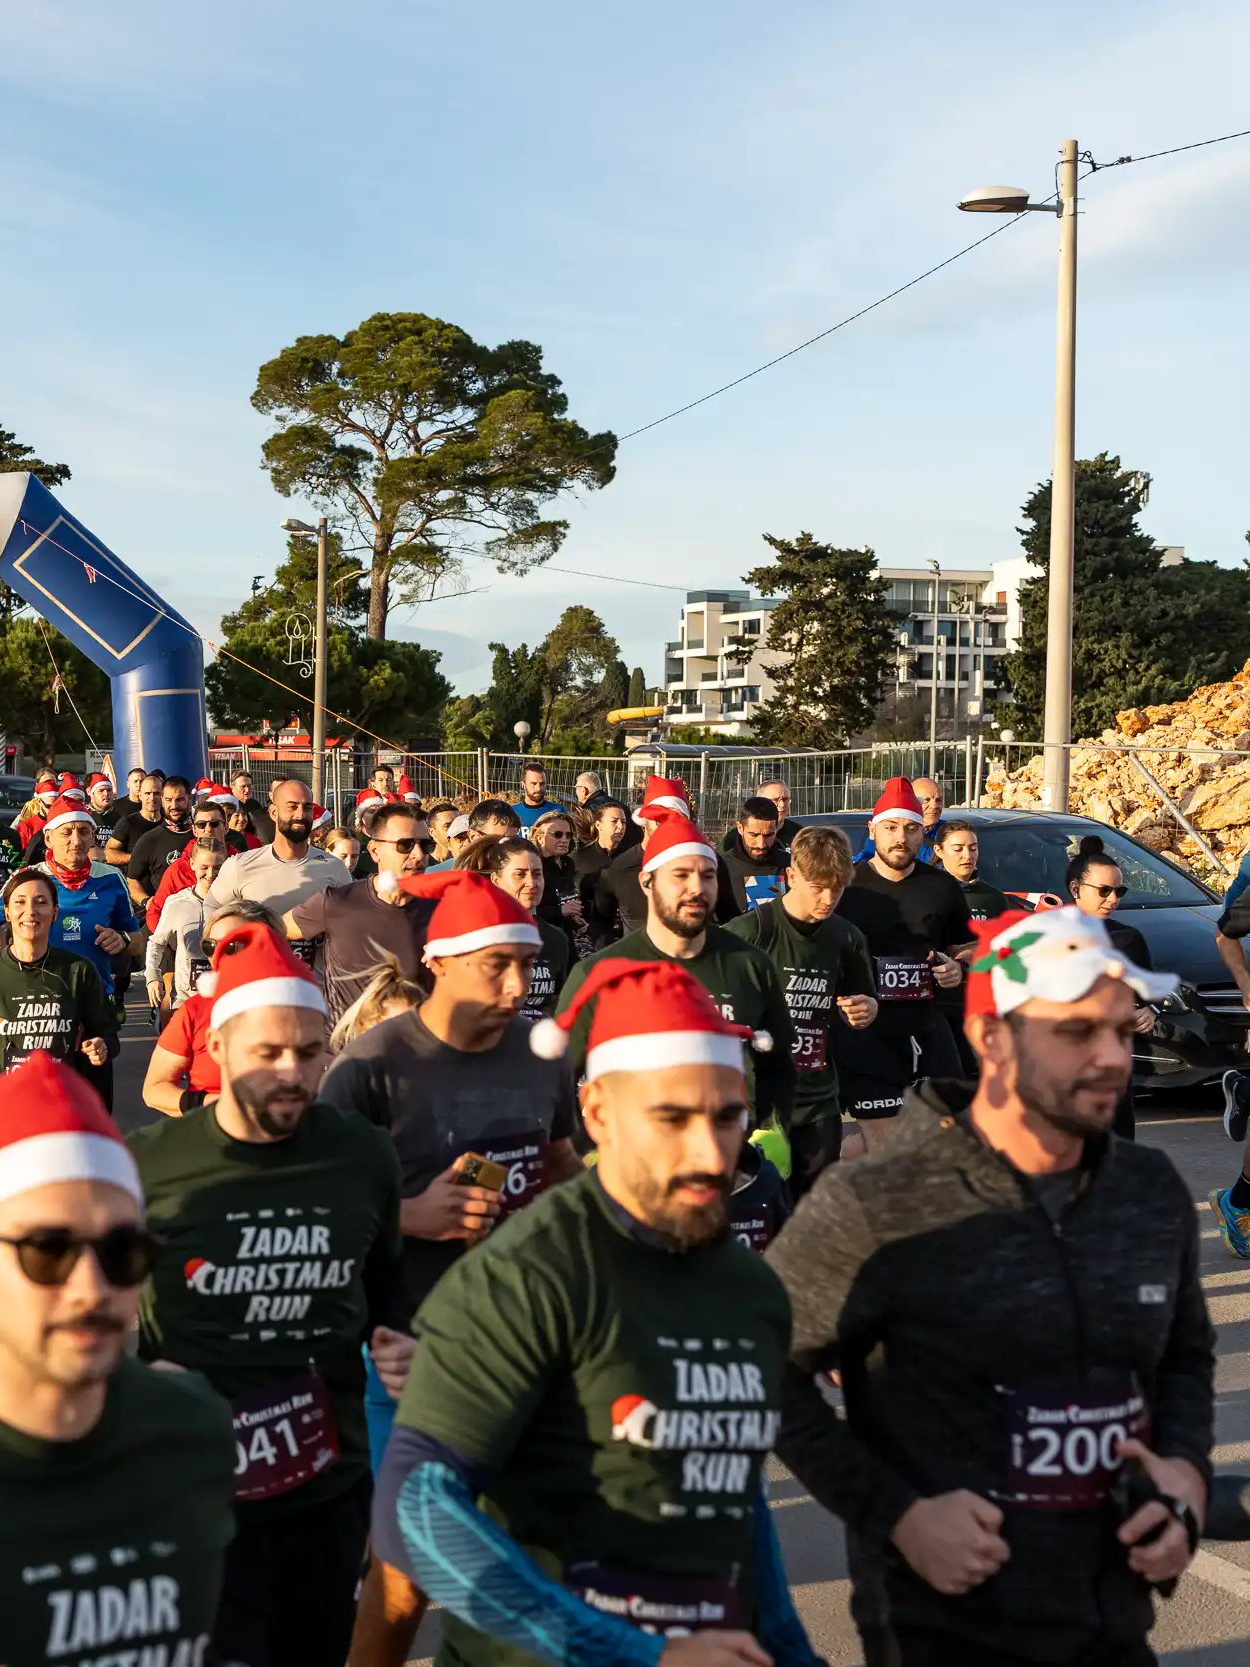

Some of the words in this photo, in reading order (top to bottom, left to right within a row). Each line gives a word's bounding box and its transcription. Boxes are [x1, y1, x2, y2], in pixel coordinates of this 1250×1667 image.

[786, 975, 828, 993] ZADAR
[885, 971, 921, 988] 034
[17, 1002, 61, 1018] ZADAR
[22, 1036, 54, 1050] RUN
[854, 1097, 906, 1110] JORDA
[236, 1224, 331, 1260] ZADAR
[192, 1259, 356, 1296] CHRISTMAS
[244, 1294, 312, 1324] RUN
[672, 1358, 767, 1403] ZADAR
[1026, 1423, 1127, 1476] 200
[681, 1450, 751, 1494] RUN
[46, 1574, 181, 1658] ZADAR
